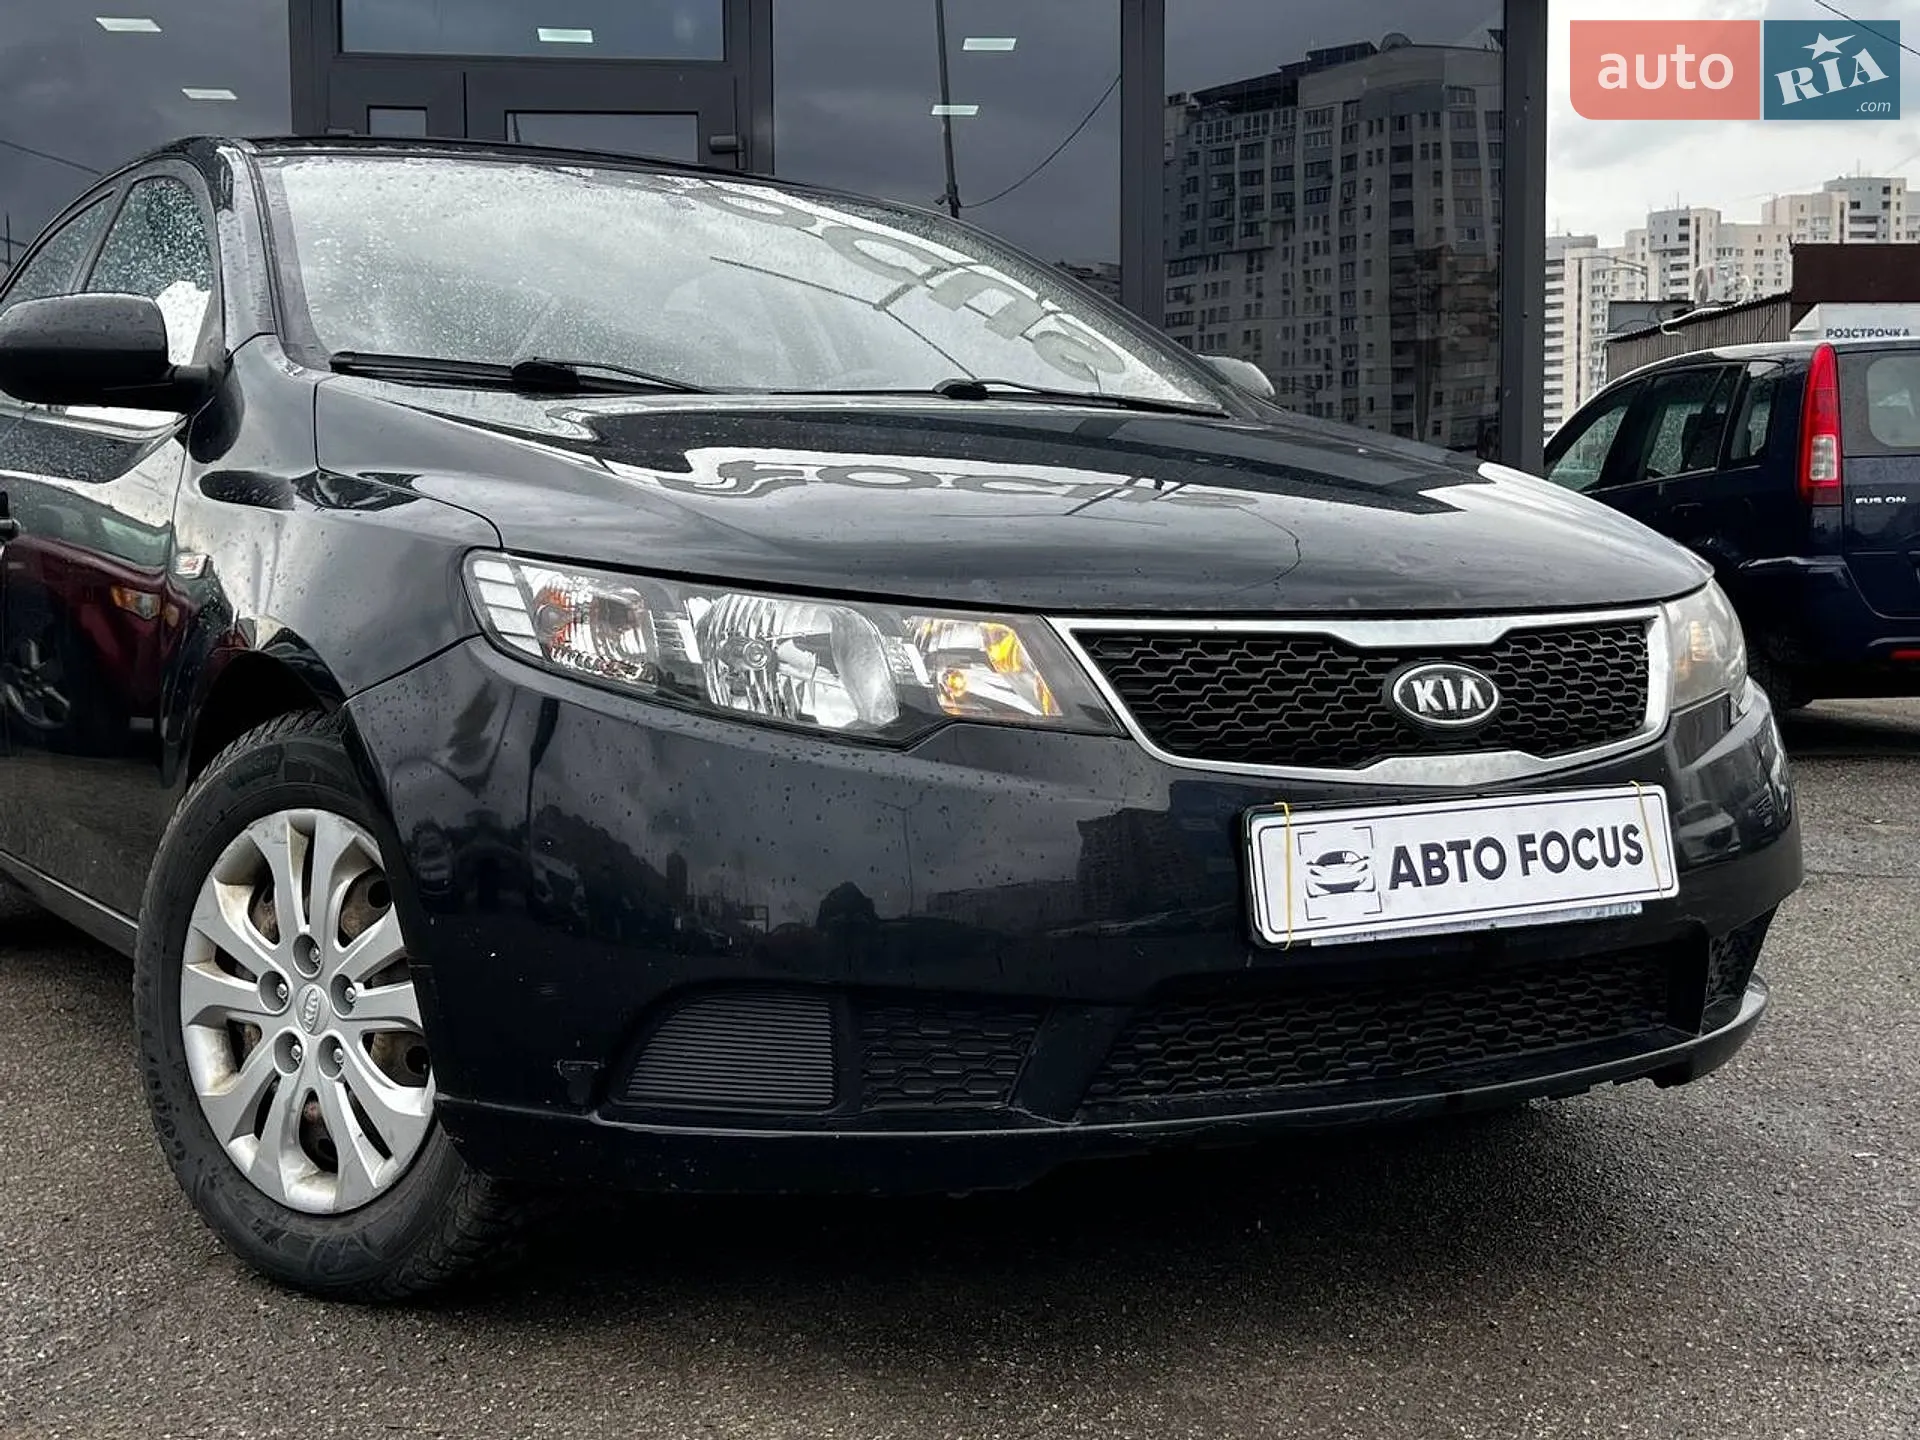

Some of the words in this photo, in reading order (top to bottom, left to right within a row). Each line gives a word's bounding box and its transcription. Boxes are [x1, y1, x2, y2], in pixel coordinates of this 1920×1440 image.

[1825, 327, 1910, 339] РОЗСТРОЧКА
[1410, 676, 1487, 714] KIA
[1388, 836, 1507, 891] АВТО
[1517, 822, 1645, 877] FOCUS
